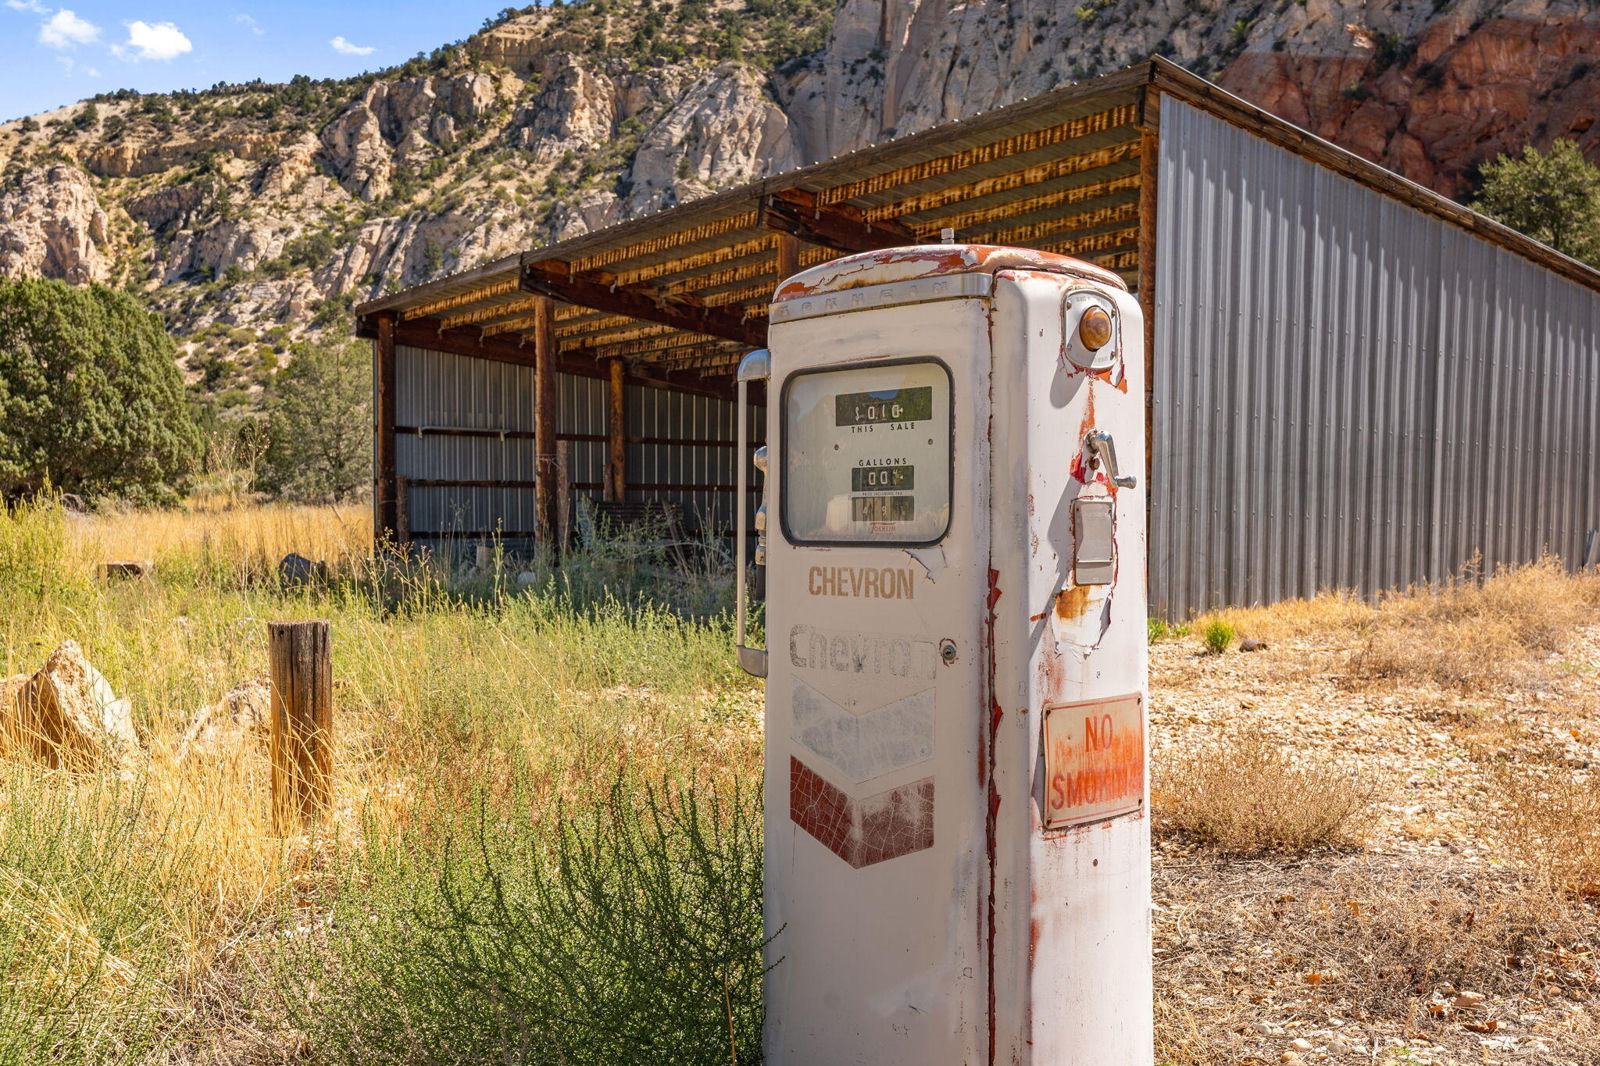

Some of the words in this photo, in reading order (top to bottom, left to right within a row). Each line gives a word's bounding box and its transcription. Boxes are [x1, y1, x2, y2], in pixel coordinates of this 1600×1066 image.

[851, 425, 874, 433] THIS
[890, 422, 915, 431] SALE
[858, 458, 907, 467] GALLONS
[808, 566, 914, 600] CHEVRON
[1085, 713, 1113, 753] NO
[1051, 760, 1143, 811] SMOKING
